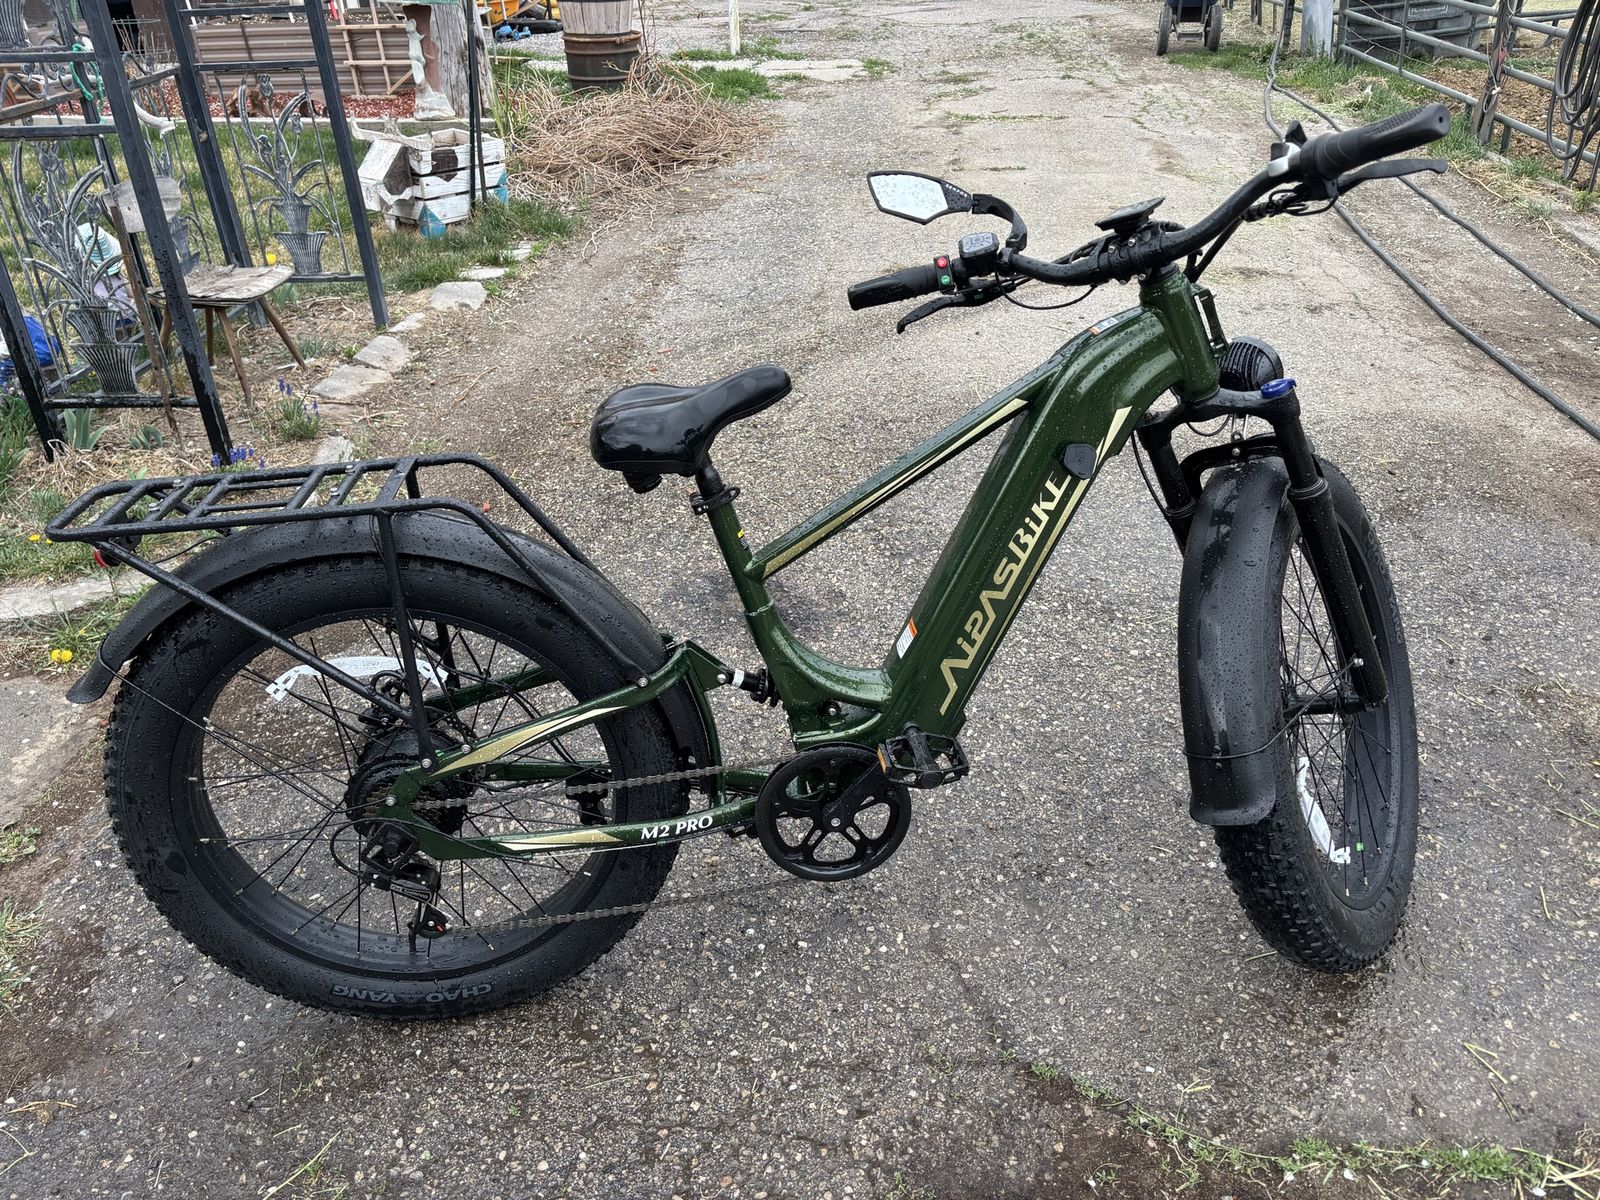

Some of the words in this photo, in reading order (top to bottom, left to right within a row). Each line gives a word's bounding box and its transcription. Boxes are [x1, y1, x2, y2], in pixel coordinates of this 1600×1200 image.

[641, 825, 670, 839] M2
[675, 815, 713, 835] PRO
[332, 985, 398, 1004] YANG
[426, 983, 492, 1003] CHAO
